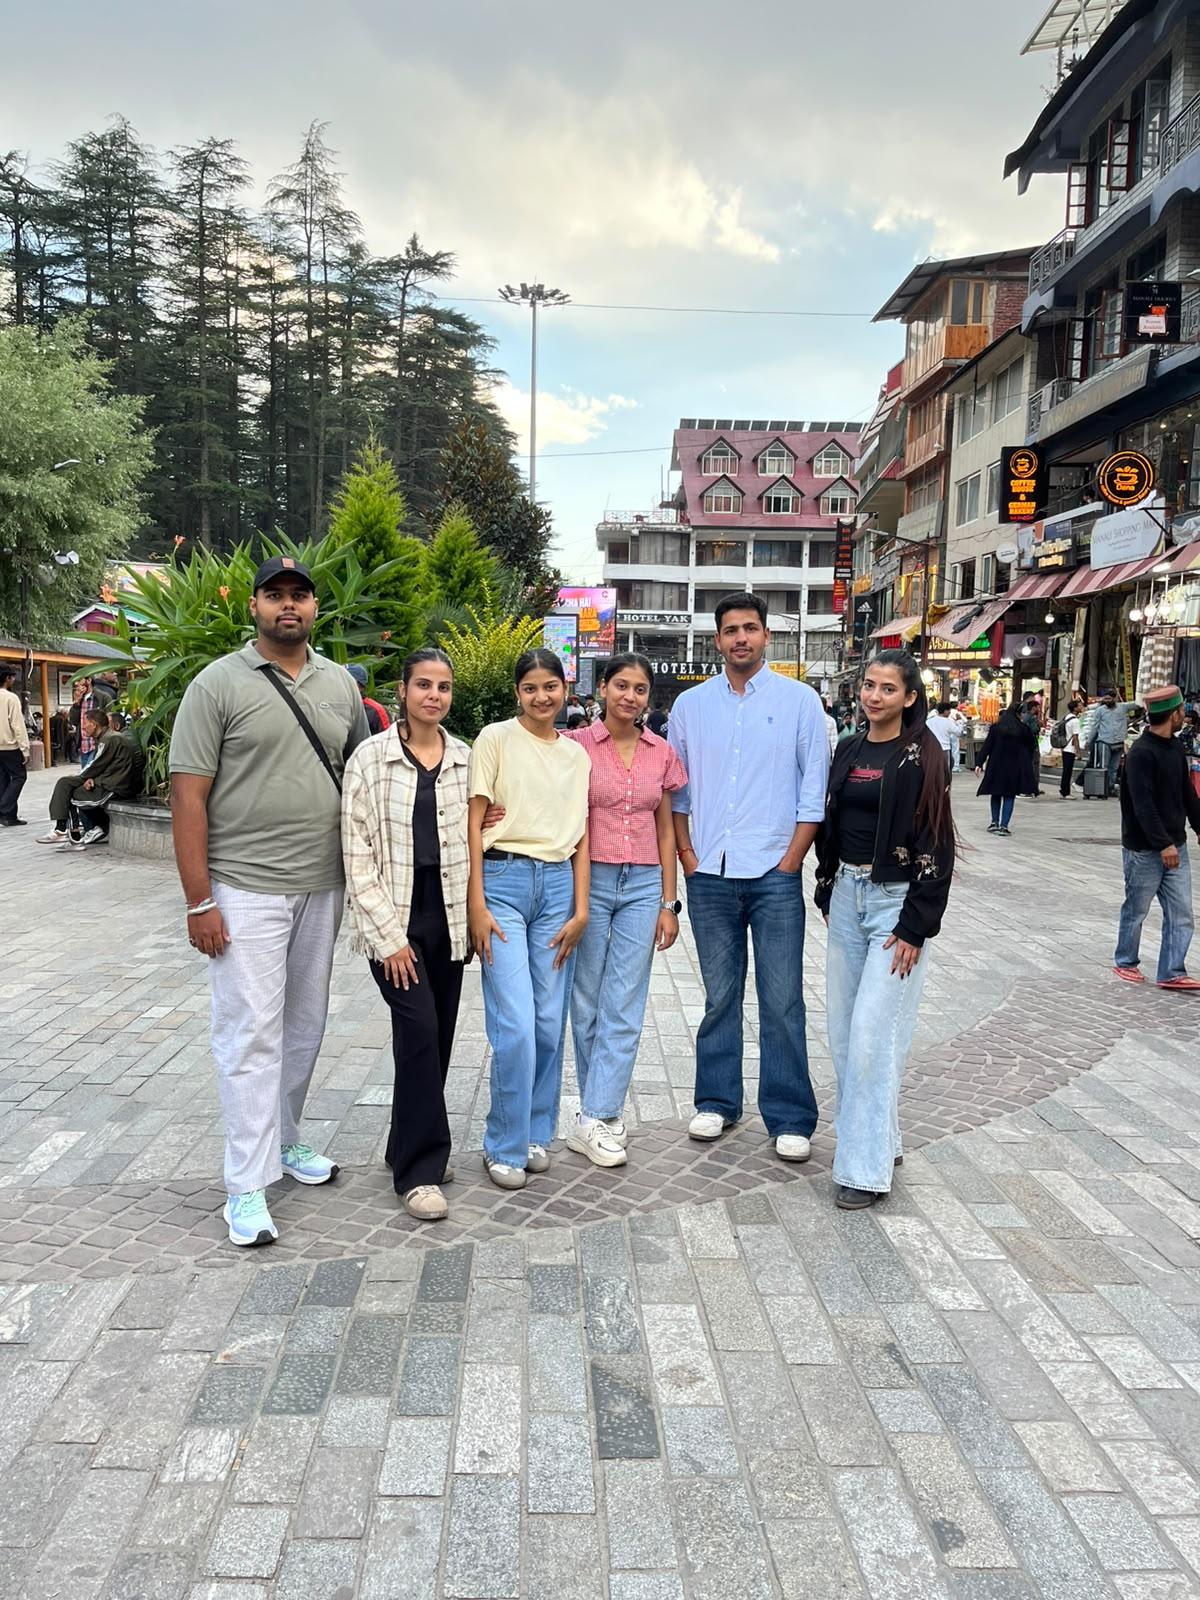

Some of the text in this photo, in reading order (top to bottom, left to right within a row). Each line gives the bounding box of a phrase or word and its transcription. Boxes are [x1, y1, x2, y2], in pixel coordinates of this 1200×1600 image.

[623, 614, 689, 623] HOTEL YAK
[650, 662, 725, 675] HOTEL YA
